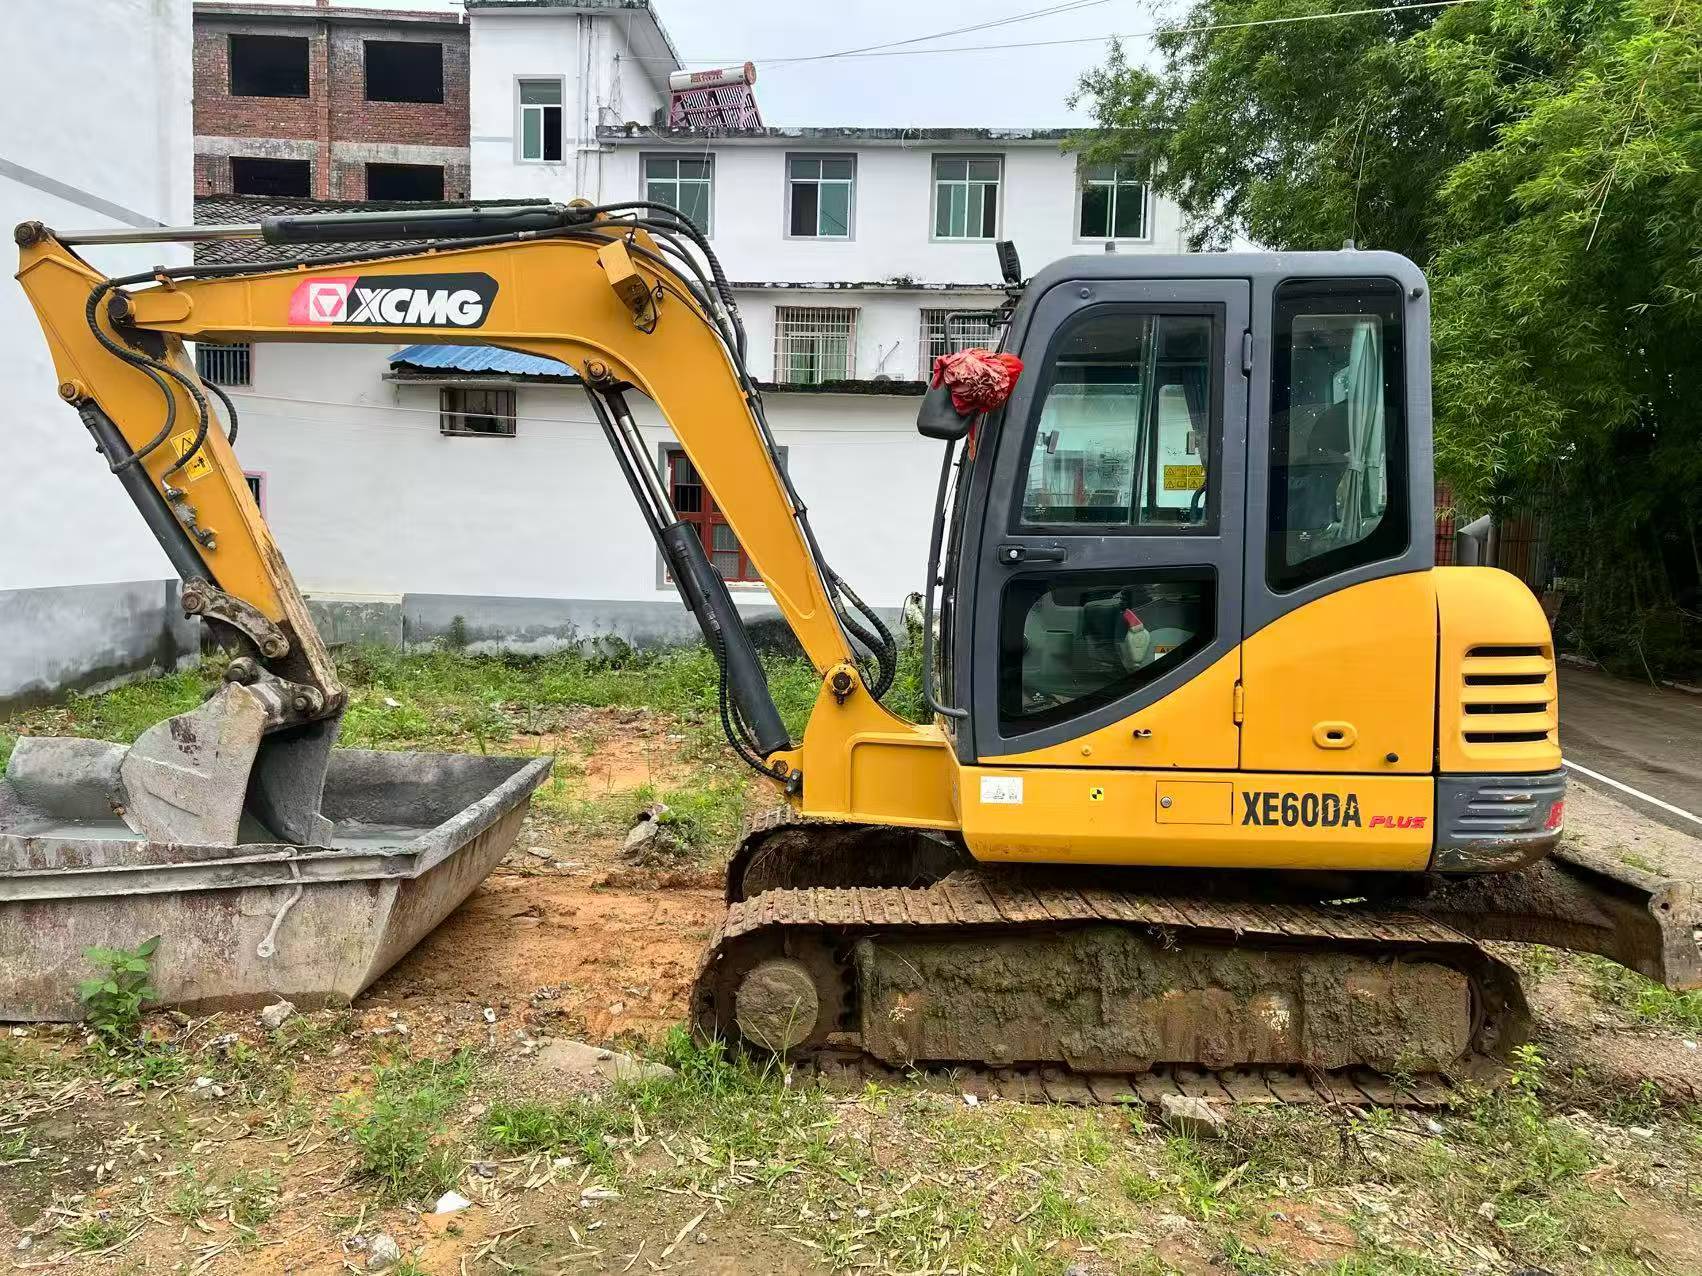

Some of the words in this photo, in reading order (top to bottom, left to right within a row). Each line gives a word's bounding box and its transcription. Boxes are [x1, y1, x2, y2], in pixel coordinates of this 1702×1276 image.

[347, 287, 484, 326] XCMG
[1241, 791, 1362, 828] XE60DA
[1368, 815, 1428, 829] PLUS
